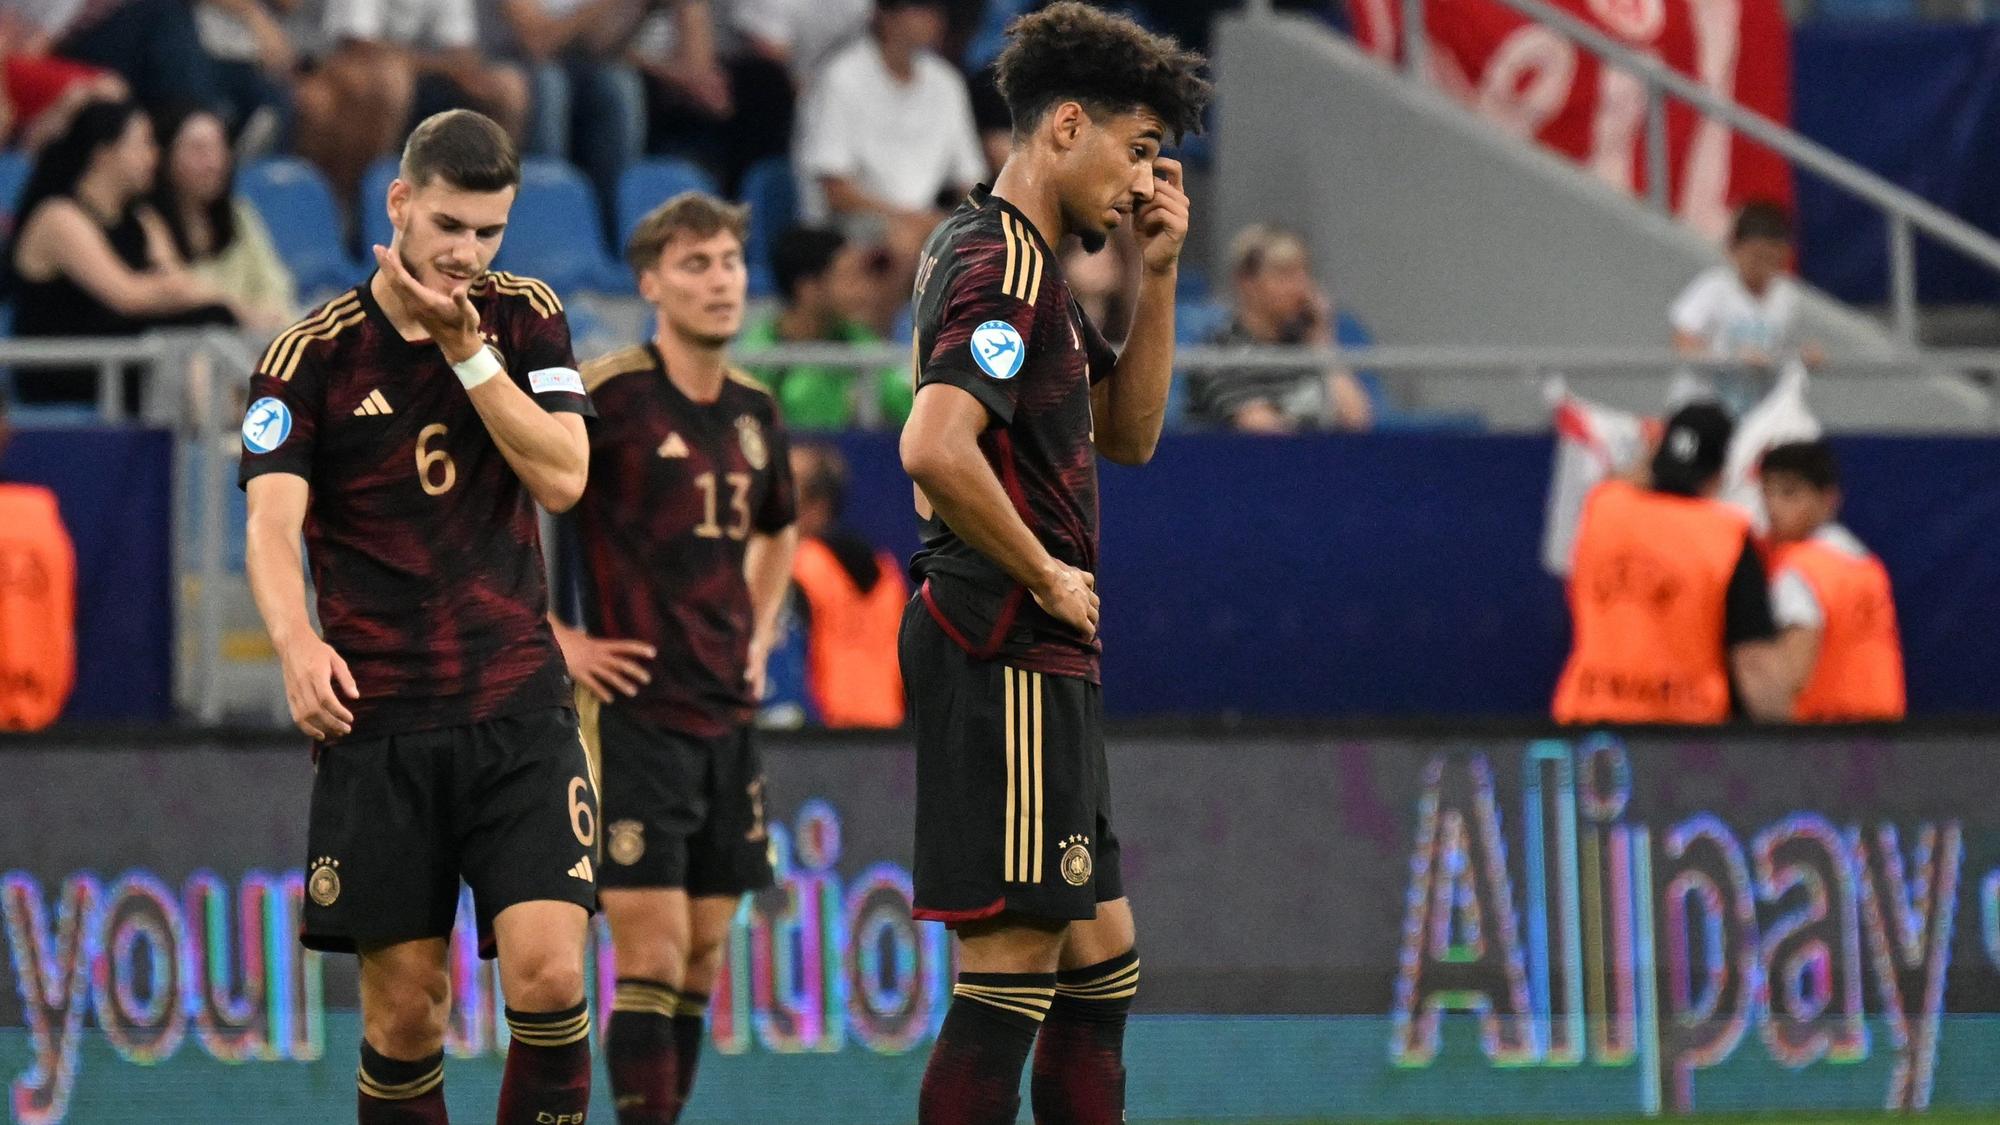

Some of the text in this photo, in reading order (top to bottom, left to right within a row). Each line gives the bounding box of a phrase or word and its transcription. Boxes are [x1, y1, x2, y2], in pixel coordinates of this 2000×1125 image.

[415, 423, 456, 496] 6
[693, 471, 752, 541] 13
[568, 776, 595, 847] 6
[1389, 733, 1964, 1114] Alipay
